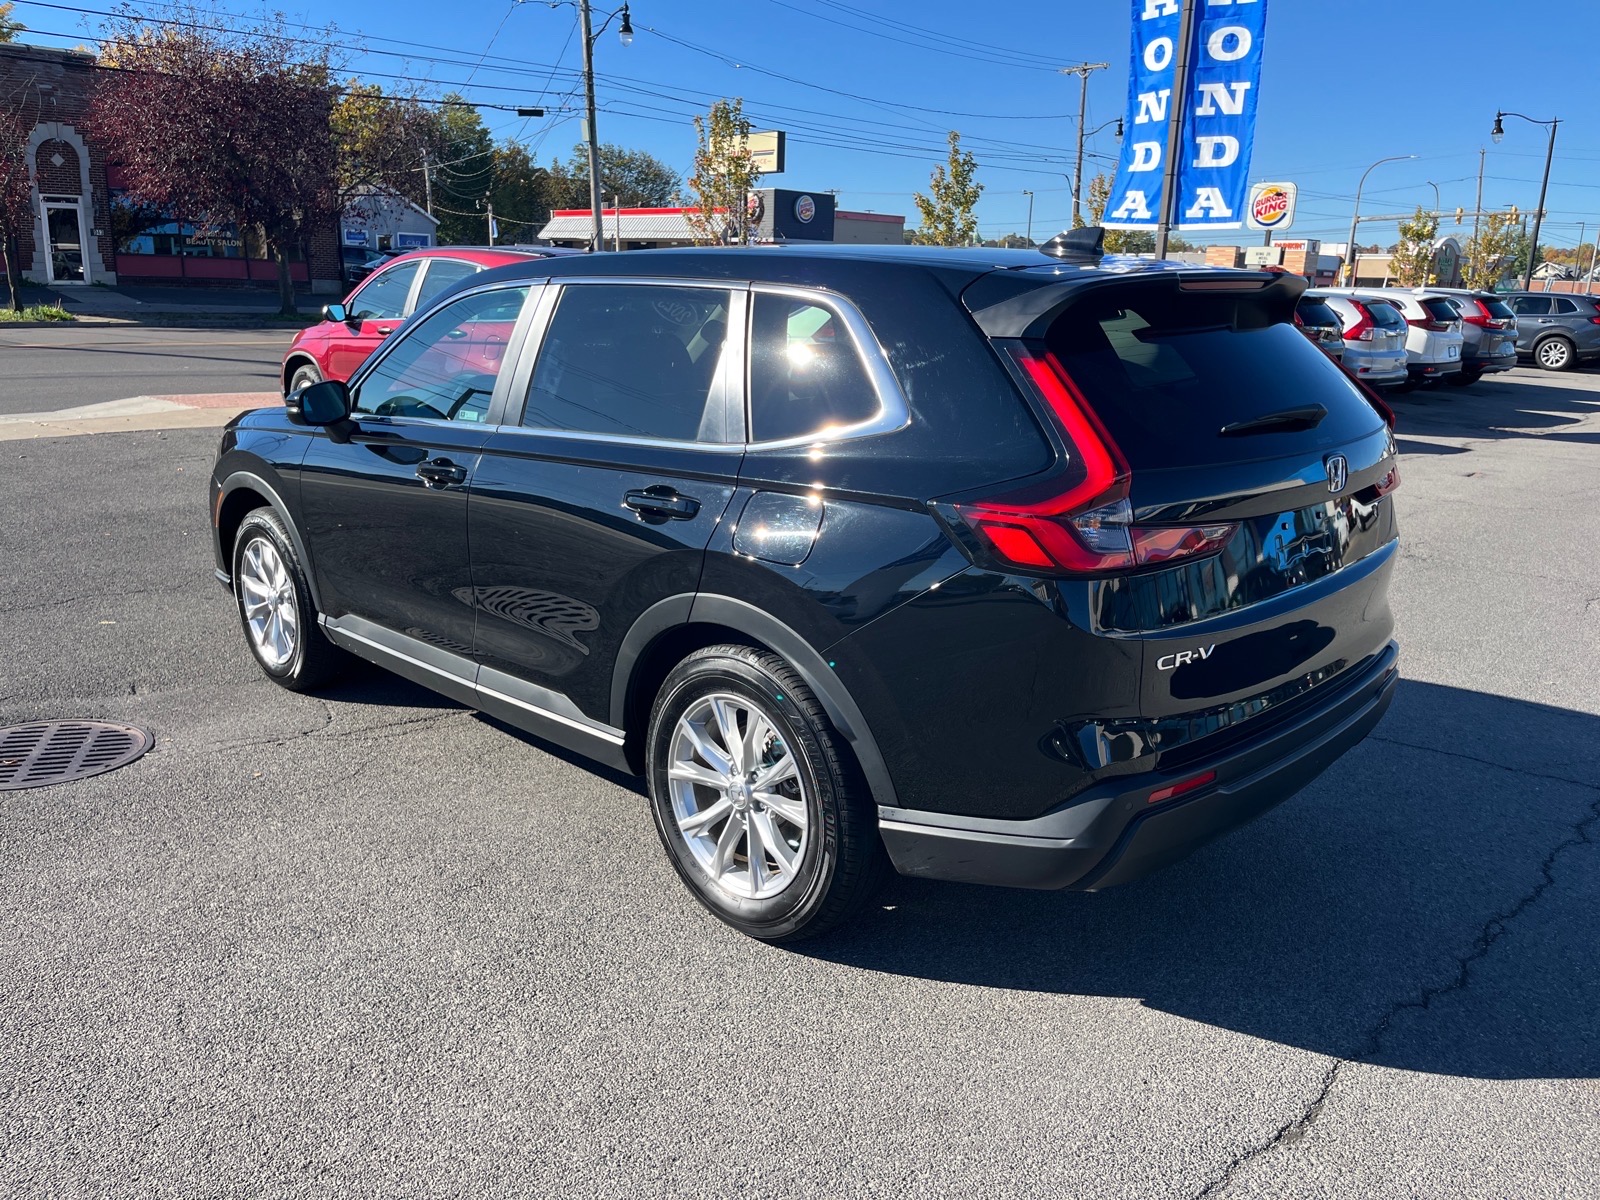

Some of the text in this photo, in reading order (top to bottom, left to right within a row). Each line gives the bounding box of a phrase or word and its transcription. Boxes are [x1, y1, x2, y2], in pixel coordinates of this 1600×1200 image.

[1185, 0, 1258, 218] ONDA
[1255, 192, 1287, 208] BURGER
[1255, 200, 1287, 218] KING
[1157, 644, 1215, 670] CR-V
